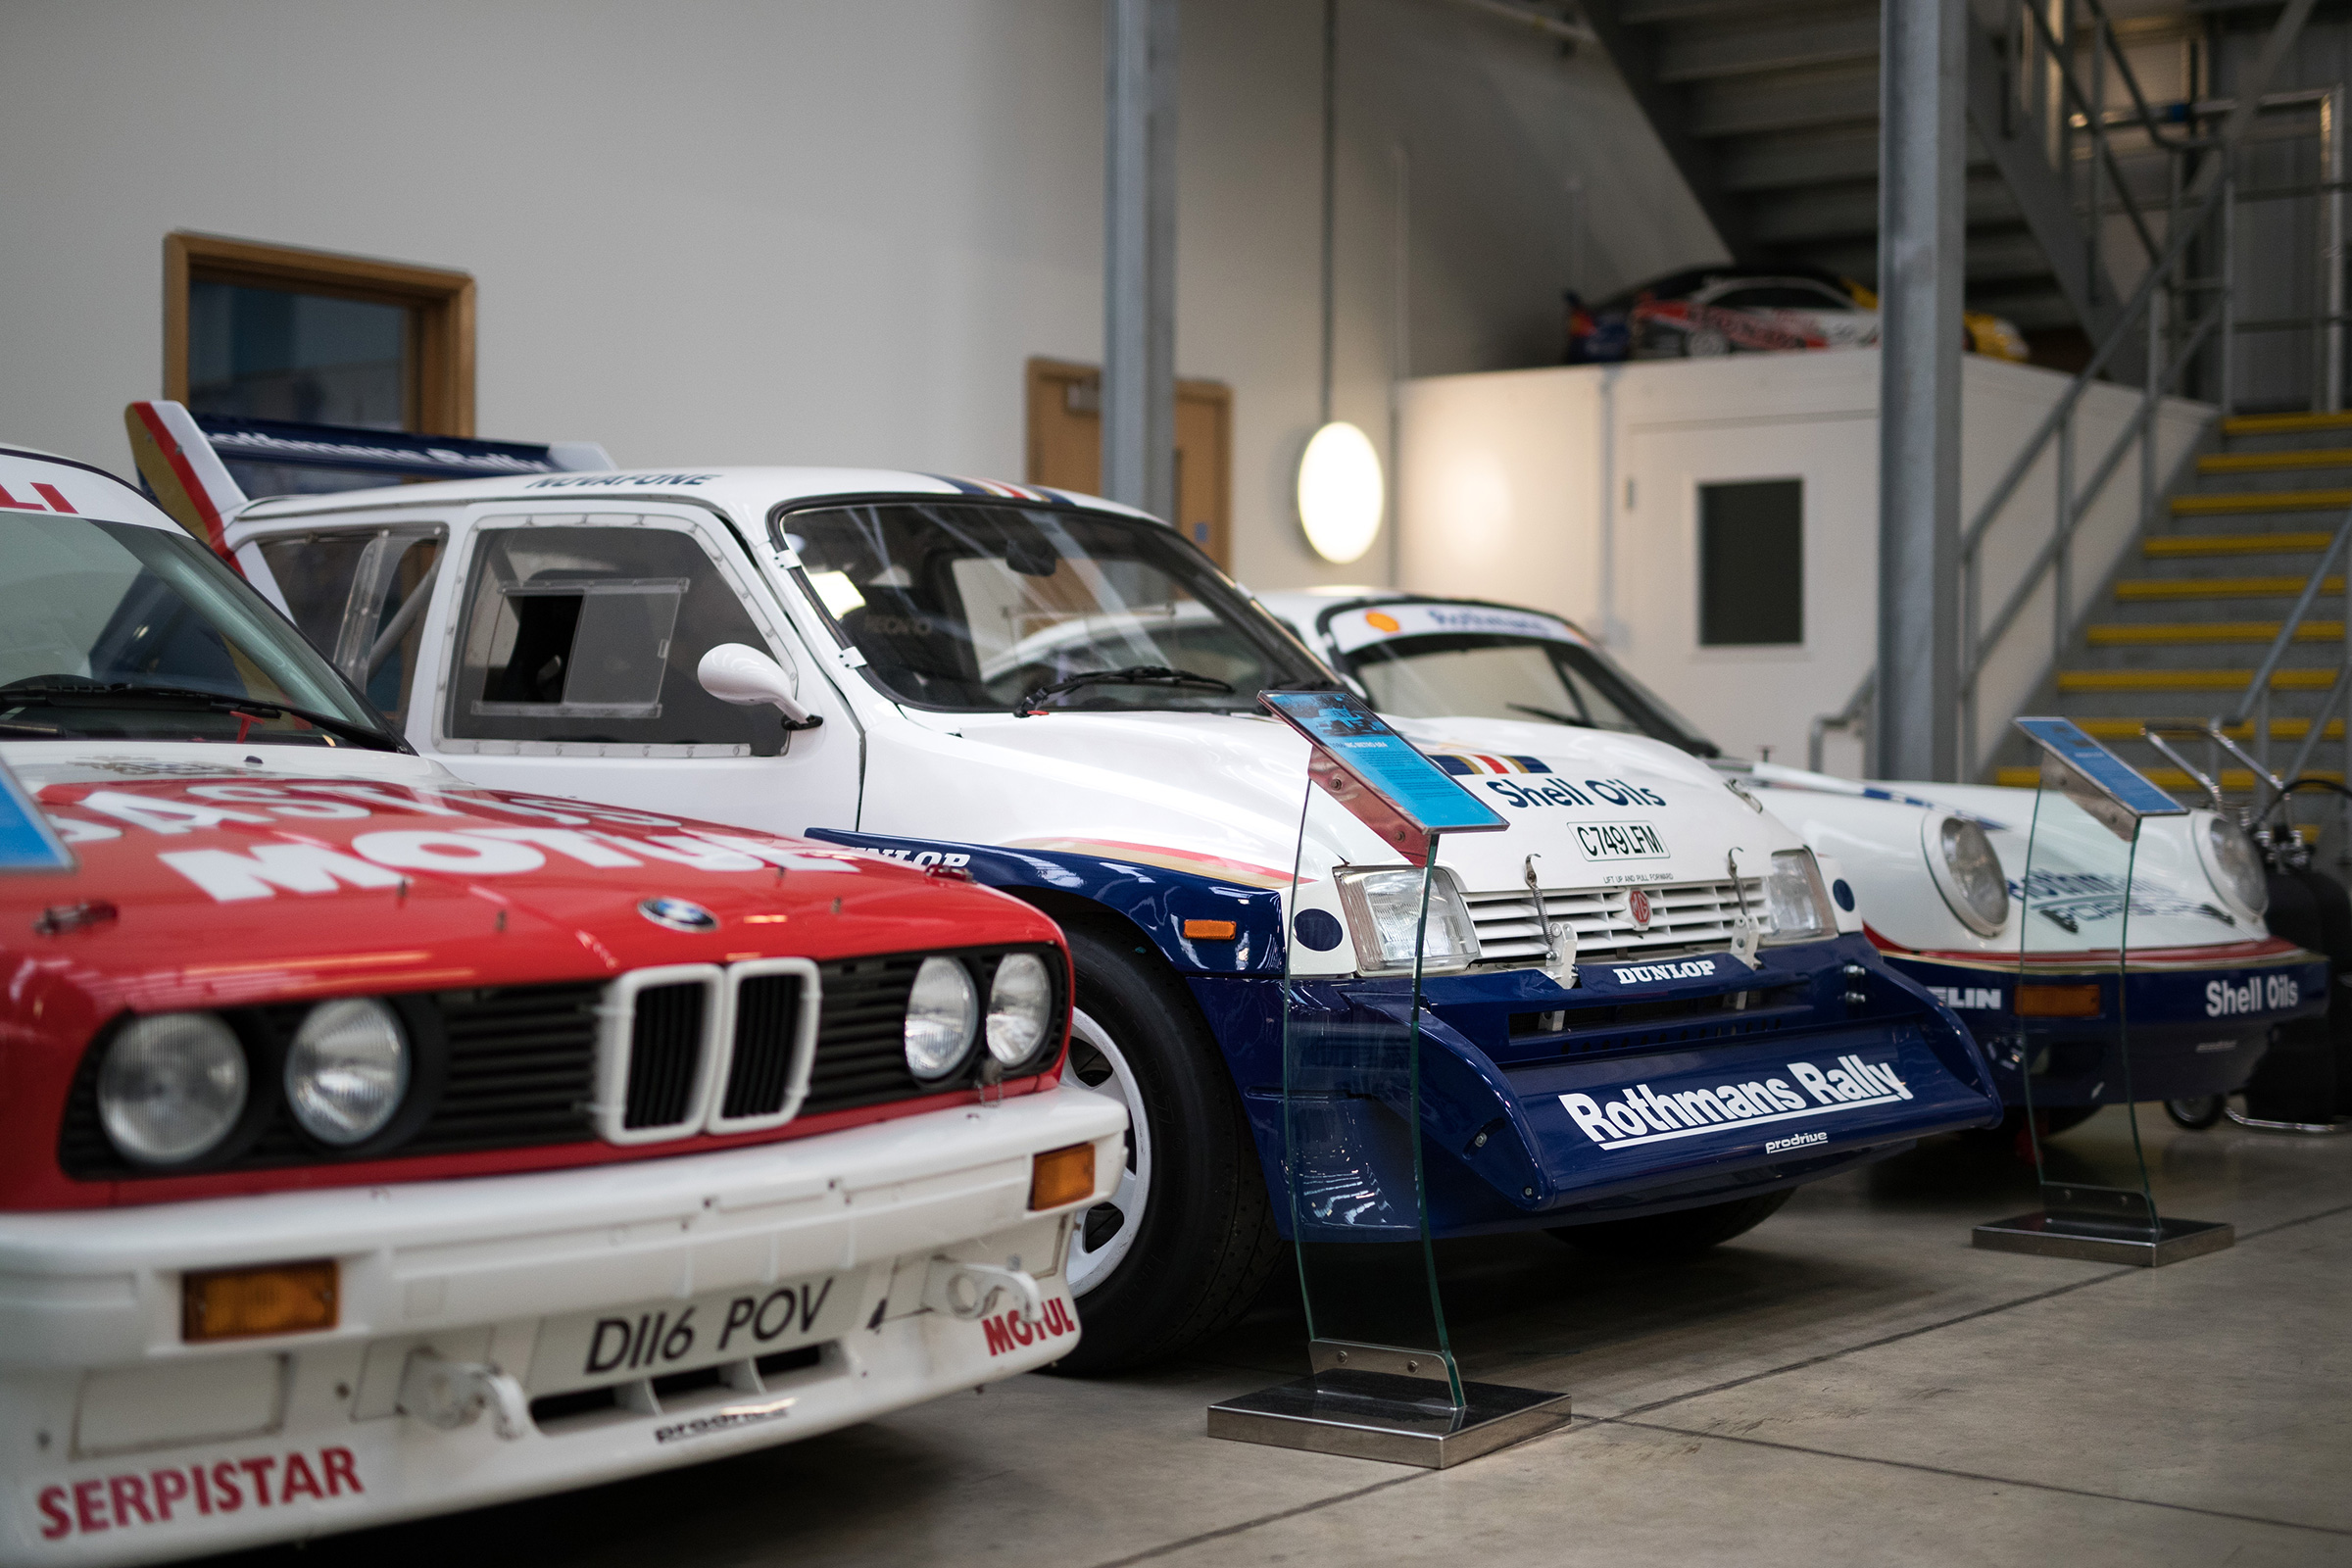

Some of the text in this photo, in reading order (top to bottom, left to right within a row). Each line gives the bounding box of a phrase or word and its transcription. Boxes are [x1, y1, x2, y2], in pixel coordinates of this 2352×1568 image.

[524, 473, 723, 489] NOVAFONE
[1486, 778, 1667, 808] Shell Oils
[1577, 825, 1665, 857] C749LFM
[156, 827, 862, 903] MOTUL
[1613, 959, 1716, 985] DUNLOP
[2205, 973, 2300, 1016] Shell Oils
[1558, 1054, 1914, 1142] Rothmans Rally
[1765, 1130, 1829, 1154] prodrive
[583, 1276, 834, 1375] D116 POV
[36, 1445, 366, 1542] SERPISTAR
